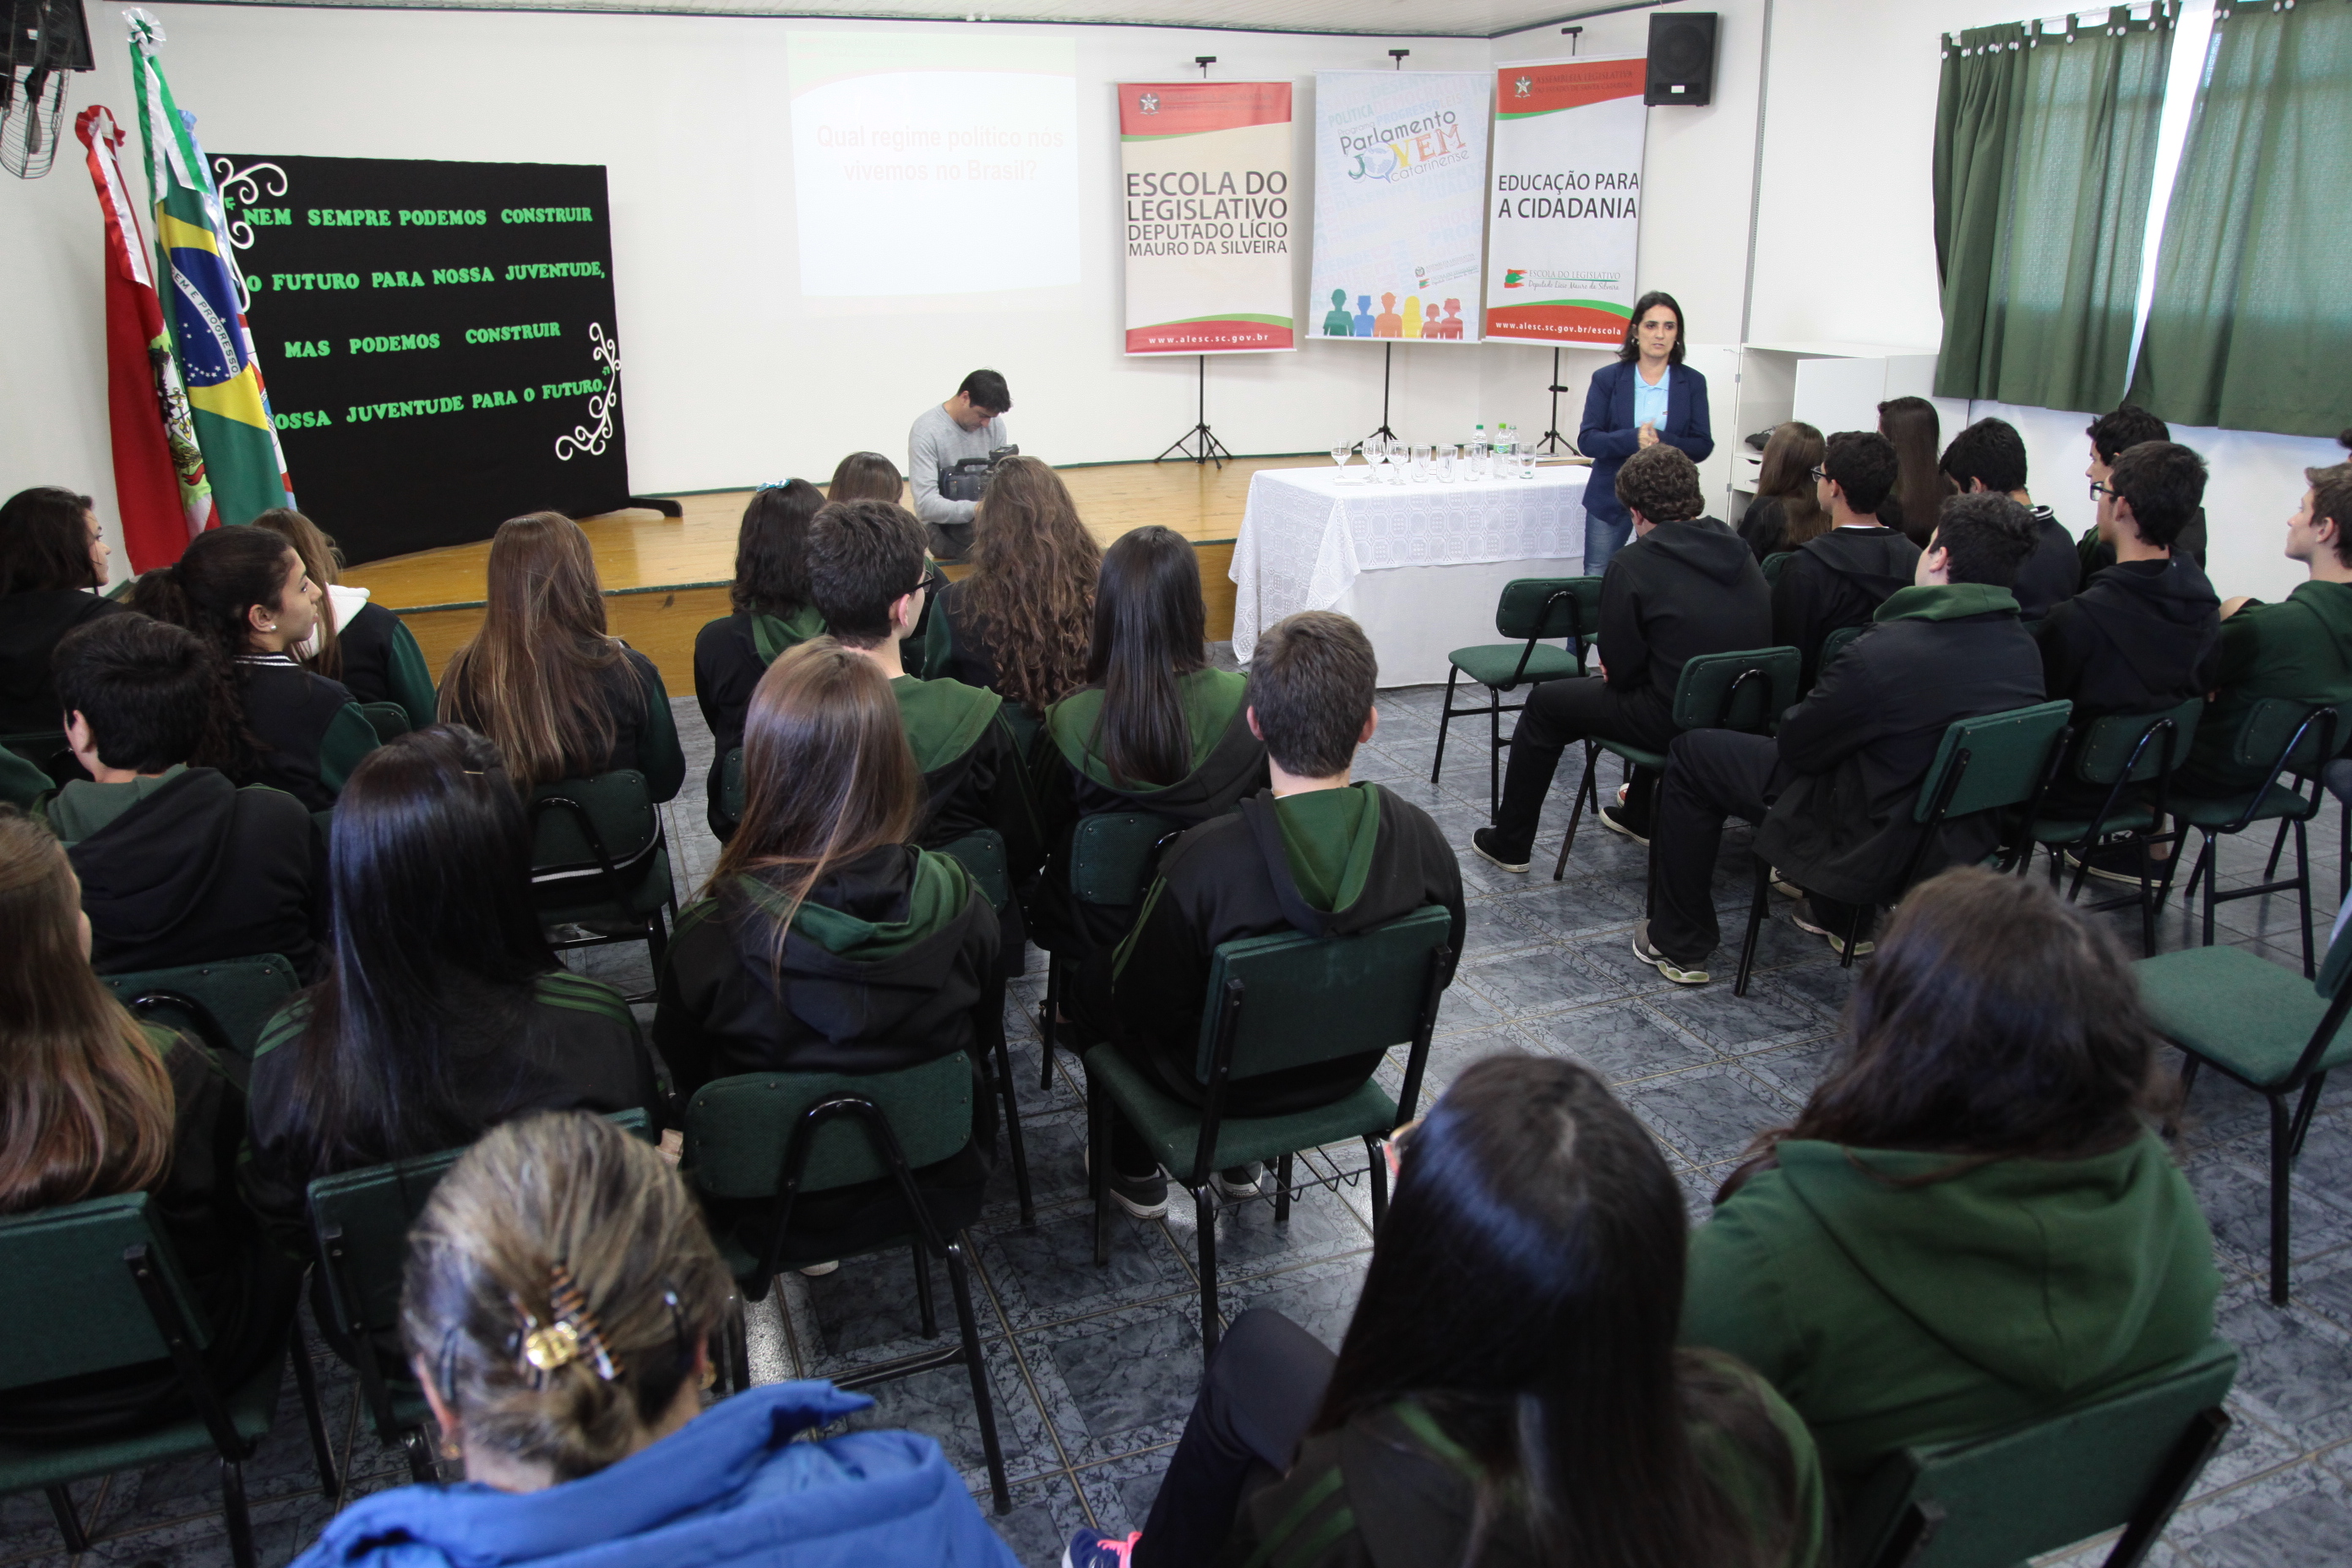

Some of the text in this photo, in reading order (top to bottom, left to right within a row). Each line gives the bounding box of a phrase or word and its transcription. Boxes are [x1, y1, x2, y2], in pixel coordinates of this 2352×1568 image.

[816, 124, 1064, 151] Qual regime político nós
[1337, 122, 1376, 138] Programa
[1340, 111, 1456, 155] Parlamento
[843, 159, 1037, 181] vivemos no Brasil?
[1391, 149, 1470, 182] catarinense
[1126, 171, 1288, 197] ESCOLA DO
[1498, 170, 1639, 195] EDUCAÇÃO PARA
[308, 209, 392, 226] SEMPRE
[399, 210, 487, 226] PODEMOS
[501, 207, 593, 224] CONSTRUIR
[1128, 197, 1288, 221] LEGISLATIVO
[1498, 197, 1636, 219] A CIDADANIA
[1128, 219, 1288, 241] DEPUTADO LÍCIO
[1129, 240, 1288, 257] MAURO DA SILVEIRA
[246, 261, 605, 291] O FUTURO PARA NOSSA JUVENTUDE,
[1528, 280, 1553, 291] Deputado
[1570, 281, 1587, 290] Mauro
[1598, 281, 1620, 291] Silveira
[1529, 270, 1555, 278] ESCOLA
[1571, 270, 1621, 280] LEGISLATIVO
[190, 291, 199, 299] E
[199, 301, 239, 373] PROGRESSO
[284, 322, 561, 357] MAS PODEMOS CONSTRUIR
[1149, 334, 1269, 344] www.alesc.sc.gov.br
[1495, 322, 1621, 335] www.alesc.sc.gov.br/escola
[271, 410, 332, 429] OSSA
[346, 395, 464, 422] JUVENTUDE
[471, 389, 518, 409] PARA
[524, 388, 536, 402] O
